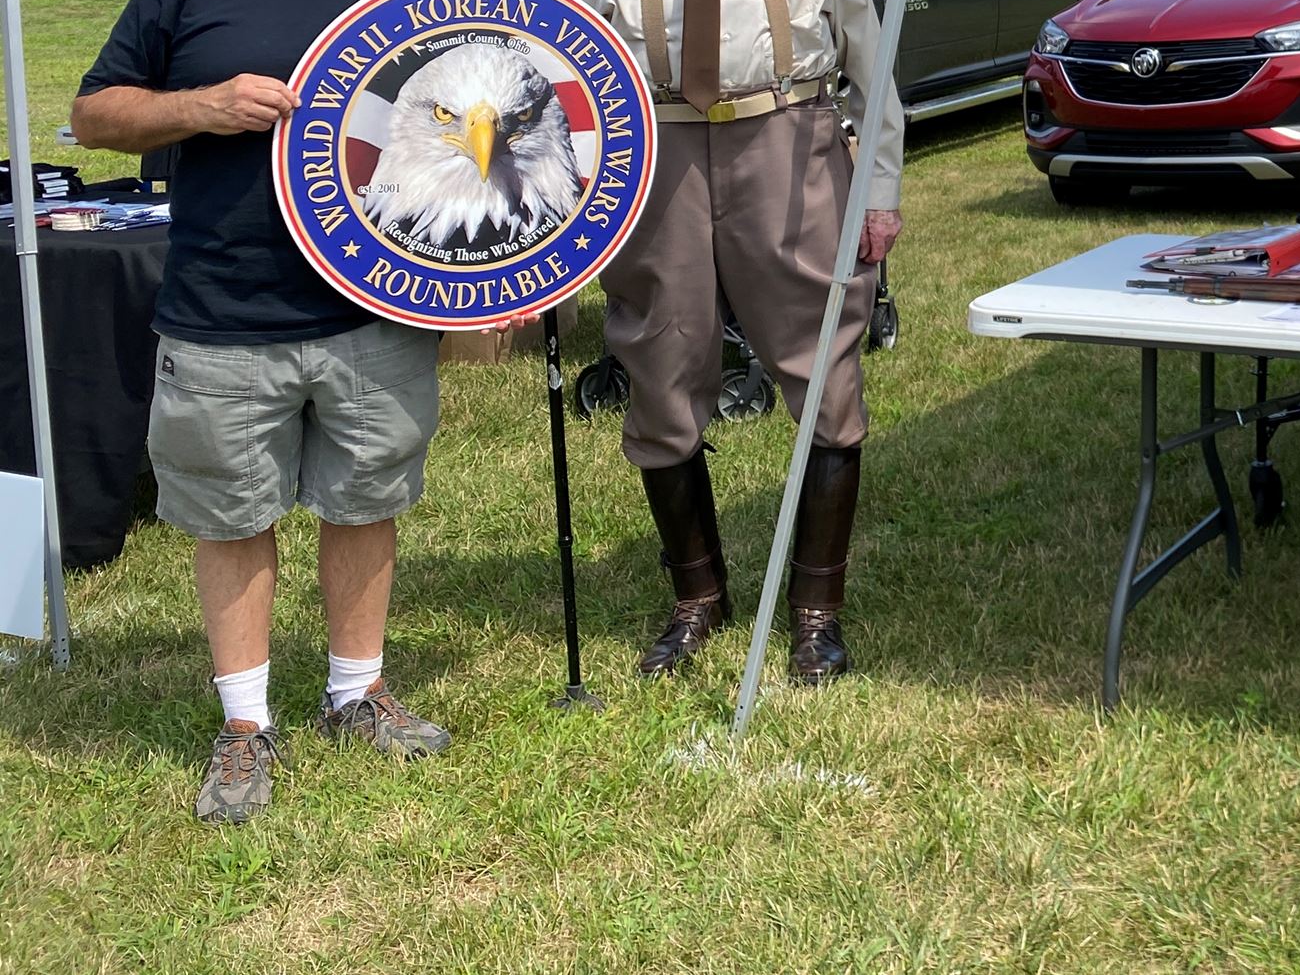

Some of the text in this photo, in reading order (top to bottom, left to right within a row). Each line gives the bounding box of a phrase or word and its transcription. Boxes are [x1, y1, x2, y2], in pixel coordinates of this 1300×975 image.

[358, 22, 394, 56] II
[425, 31, 531, 56] Summit County, Ohio
[310, 46, 372, 110] WAR
[554, 17, 632, 141] VIETNAM
[303, 119, 352, 236] WORLD
[358, 183, 401, 194] est. 2001
[584, 146, 633, 229] WARS
[383, 216, 556, 264] Recognizing Those Who Served
[362, 250, 571, 310] ROUNDTABLE
